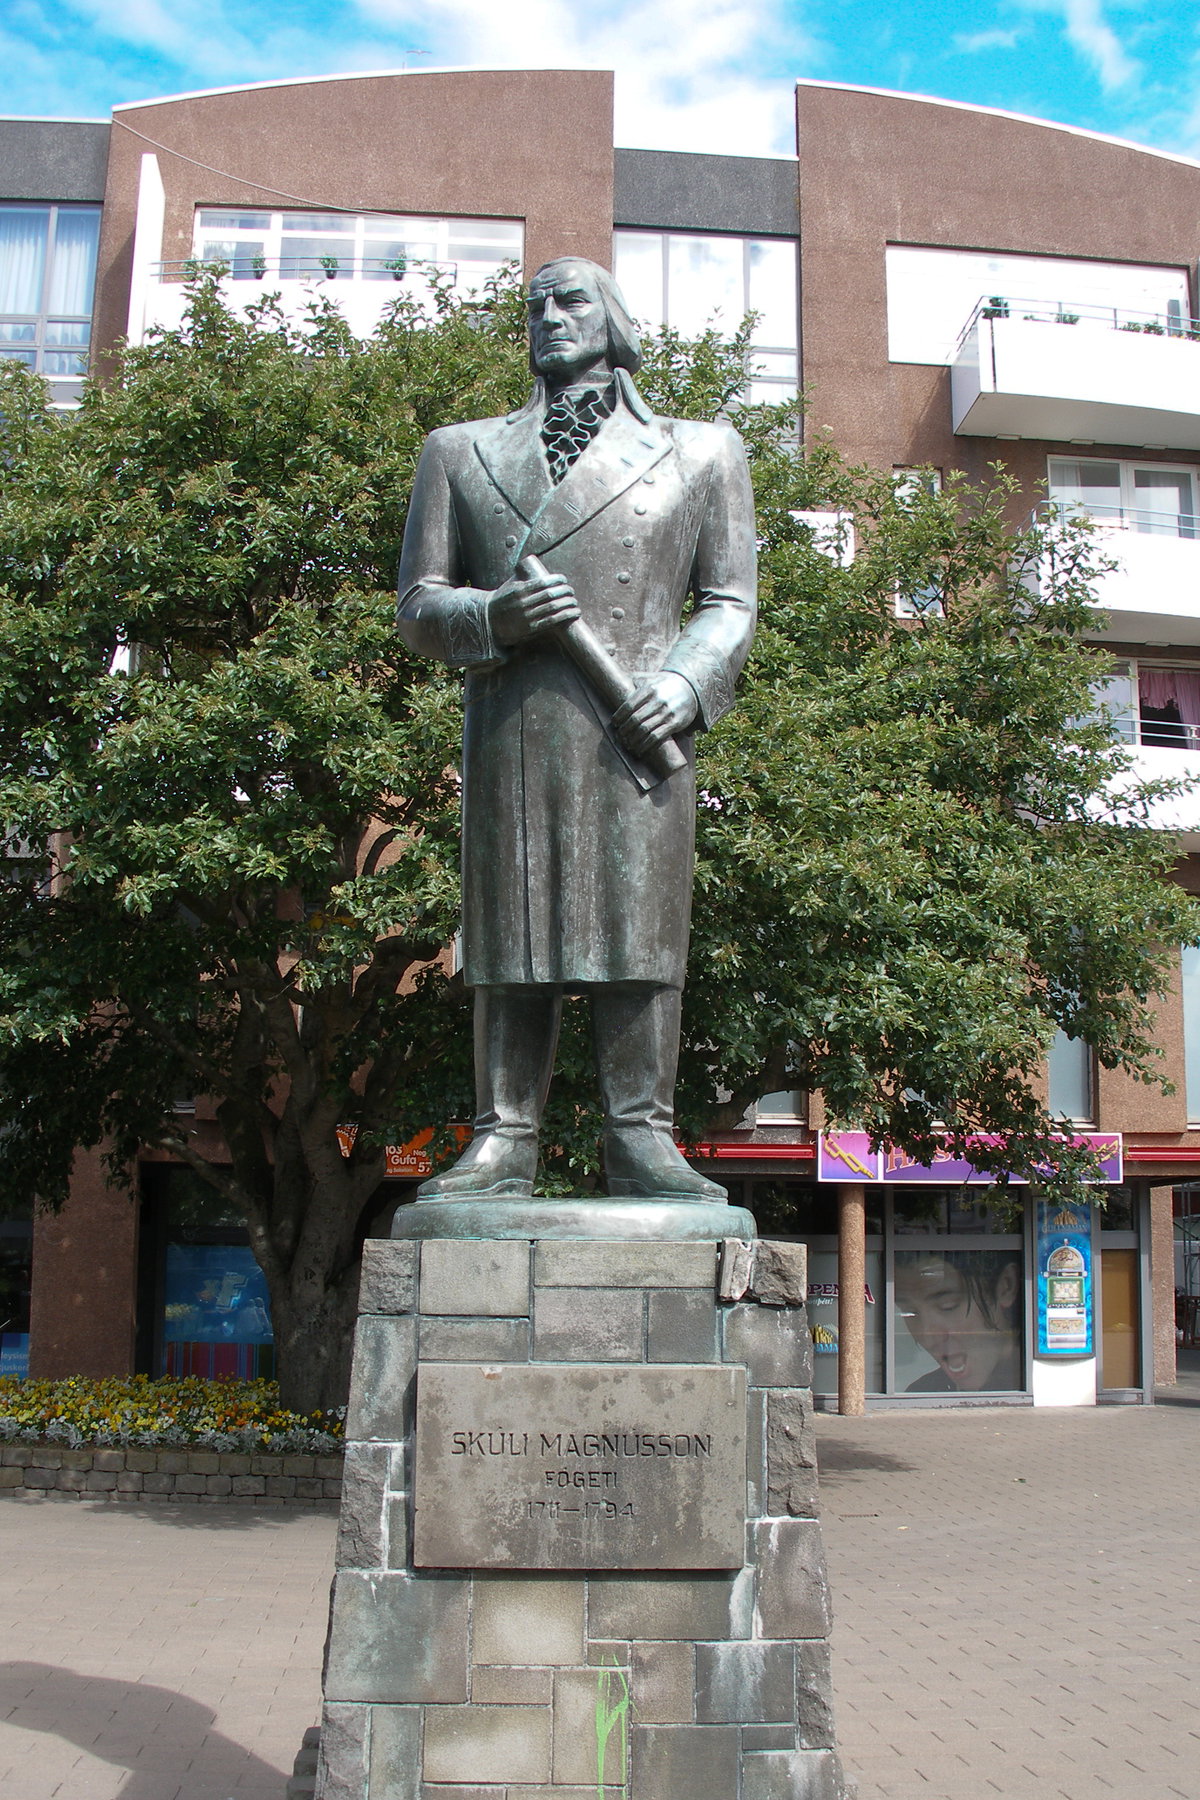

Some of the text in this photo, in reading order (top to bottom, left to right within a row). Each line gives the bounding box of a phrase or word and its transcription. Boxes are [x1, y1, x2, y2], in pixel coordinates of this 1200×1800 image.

[391, 1155, 417, 1165] Gufa
[451, 1426, 713, 1458] SKÚLI MAGNÚSSON
[544, 1467, 618, 1490] FÓGETI
